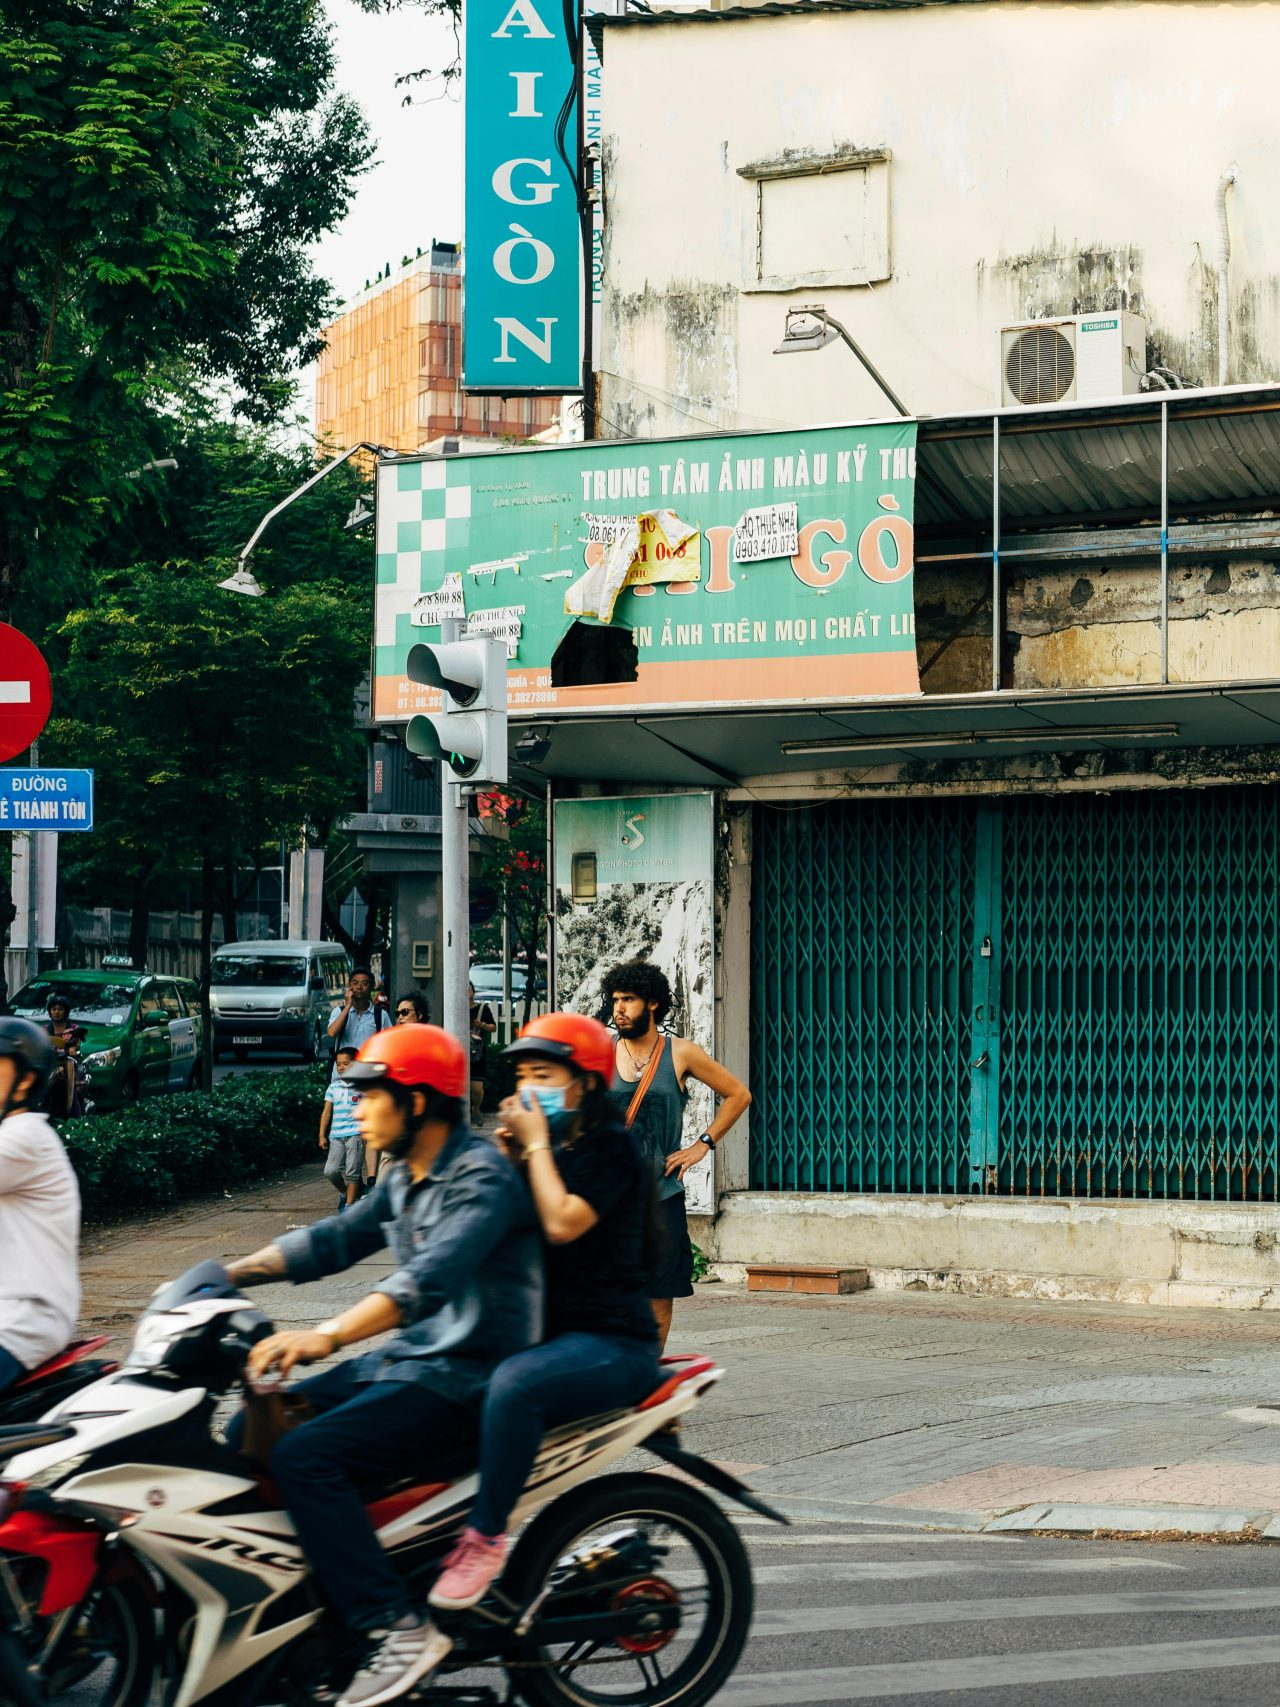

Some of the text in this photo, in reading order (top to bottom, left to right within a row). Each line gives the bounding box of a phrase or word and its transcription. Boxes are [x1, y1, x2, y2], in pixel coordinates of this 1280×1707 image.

[1083, 320, 1116, 332] TOSHIBA
[581, 465, 650, 501] TRUNG
[659, 458, 710, 495] TÂM
[718, 452, 765, 492] ẢNH
[773, 449, 828, 488] MÀU
[837, 444, 867, 483] KỸ
[755, 507, 778, 537] THUÊ
[778, 504, 797, 533] NHÀ
[735, 533, 796, 559] 0903.410.073
[660, 618, 703, 647] ẢNH
[712, 618, 767, 645] TRÊN
[774, 618, 817, 647] MỌI
[825, 609, 882, 640] CHẤT
[12, 775, 68, 792] ĐƯỜNG
[0, 796, 86, 820] Ê THÁNH TÔN
